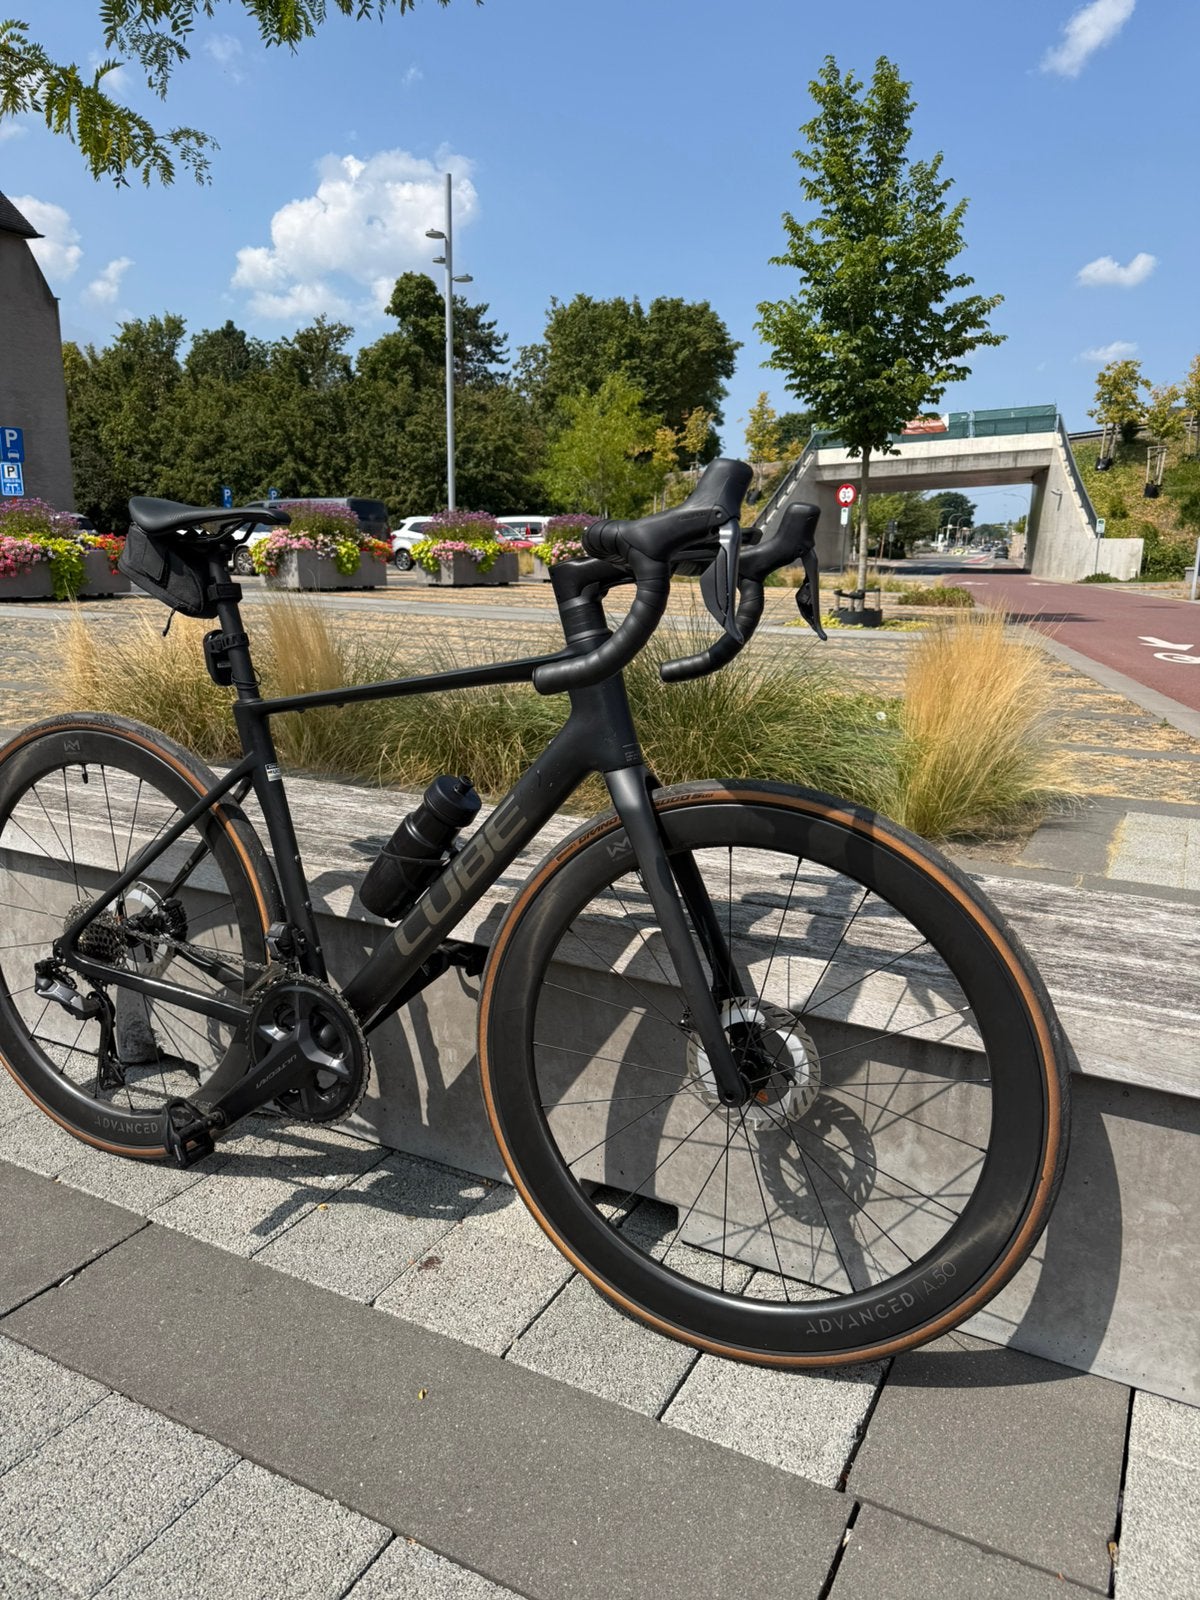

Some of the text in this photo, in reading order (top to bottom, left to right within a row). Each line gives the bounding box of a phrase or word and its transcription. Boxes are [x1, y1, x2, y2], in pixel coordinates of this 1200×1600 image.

[5, 429, 17, 447] P
[7, 466, 15, 477] P
[224, 489, 231, 500] P
[271, 490, 277, 500] P
[394, 794, 527, 956] CUBE
[95, 1116, 158, 1134] ADVANCED
[806, 1292, 915, 1335] ADVANCED
